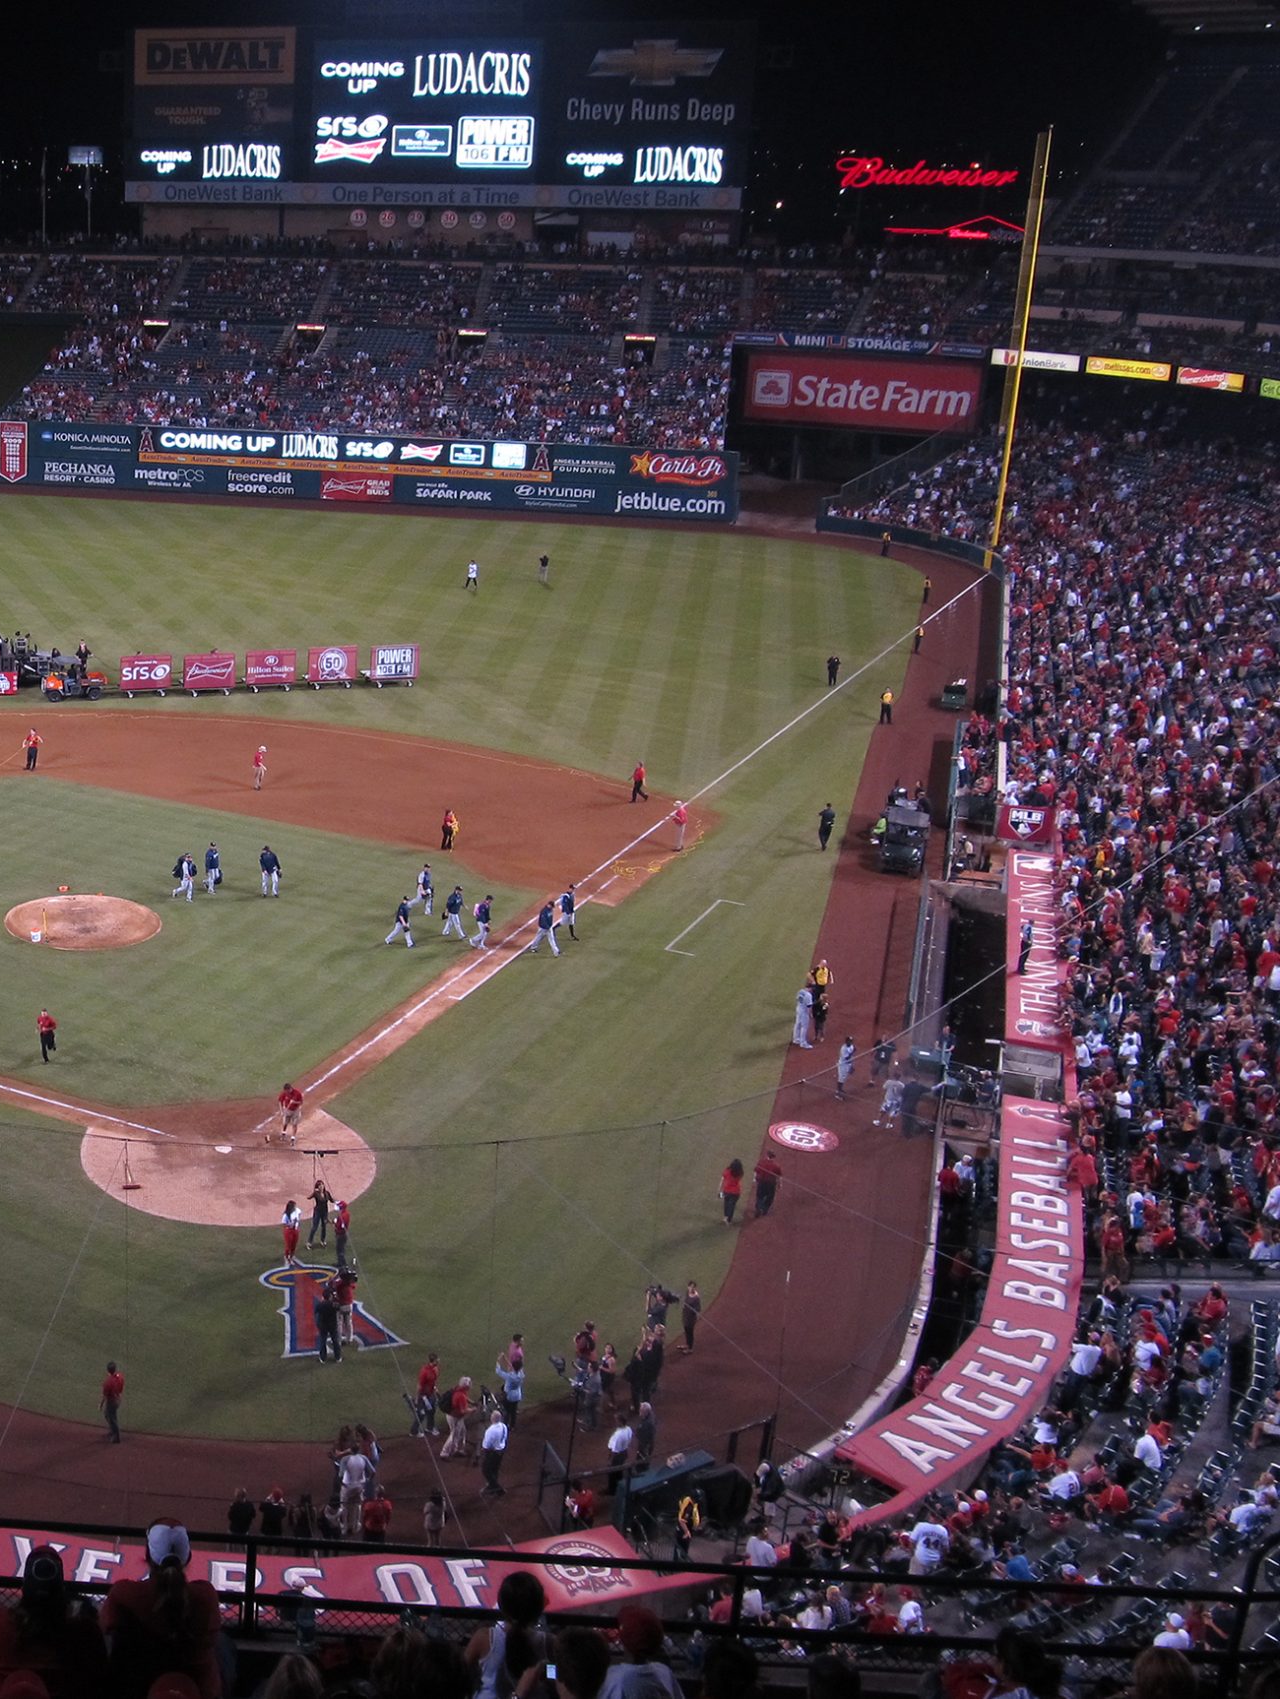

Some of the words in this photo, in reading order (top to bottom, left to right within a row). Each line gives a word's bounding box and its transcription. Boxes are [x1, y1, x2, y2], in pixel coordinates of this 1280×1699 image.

[147, 38, 284, 71] DEWALT
[321, 62, 405, 78] COMING
[412, 52, 530, 96] LUDACRIS
[348, 79, 377, 93] UP
[155, 106, 220, 116] GUARANTEED
[567, 99, 625, 124] Chevy
[631, 99, 680, 121] Runs
[687, 99, 735, 124] Deep
[462, 120, 528, 145] POWER
[141, 150, 191, 162] COMING
[203, 144, 280, 178] LUDACRIS
[464, 148, 489, 160] 106
[566, 152, 623, 165] COMING
[157, 163, 175, 173] UP
[584, 165, 605, 177] UP
[634, 146, 723, 183] LUDACRIS
[836, 157, 1019, 187] Budweiser
[165, 185, 236, 201] OneWest
[243, 186, 283, 201] Bank
[333, 186, 367, 201] One
[373, 187, 433, 202] Person
[438, 187, 455, 202] at
[461, 190, 469, 203] a
[471, 187, 519, 204] Time
[568, 189, 648, 206] OneWest
[655, 190, 699, 207] Bank
[795, 335, 825, 347] MINI
[794, 375, 879, 409] State
[881, 381, 972, 416] Farm
[54, 433, 89, 442] KONICA
[91, 433, 131, 445] MINOLTA
[160, 433, 242, 451] COMING
[247, 437, 275, 452] UP
[282, 434, 338, 460] LUDACRIS
[44, 462, 115, 475] PECHANGA
[553, 466, 615, 475] FOUNDATION
[649, 456, 695, 475] Carl's
[44, 474, 76, 482] RESORT
[84, 476, 115, 484] CASINO
[134, 468, 204, 482] metroPCS
[228, 470, 292, 483] freecredit
[228, 483, 294, 494] score.com
[367, 488, 389, 496] BUDS
[416, 488, 457, 499] SAFARI
[460, 489, 491, 501] PARK
[538, 486, 596, 498] HYUNDAI
[615, 490, 725, 514] jetblue.com
[325, 657, 339, 668] 50
[378, 649, 412, 664] POWER
[379, 664, 393, 674] 106
[397, 663, 410, 673] FM
[1012, 810, 1042, 821] MLB
[1021, 958, 1058, 1014] THANK
[1003, 1136, 1071, 1310] BASEBALL
[879, 1319, 1057, 1474] ANGELS
[830, 1469, 851, 1485] 72
[375, 1558, 488, 1608] OF
